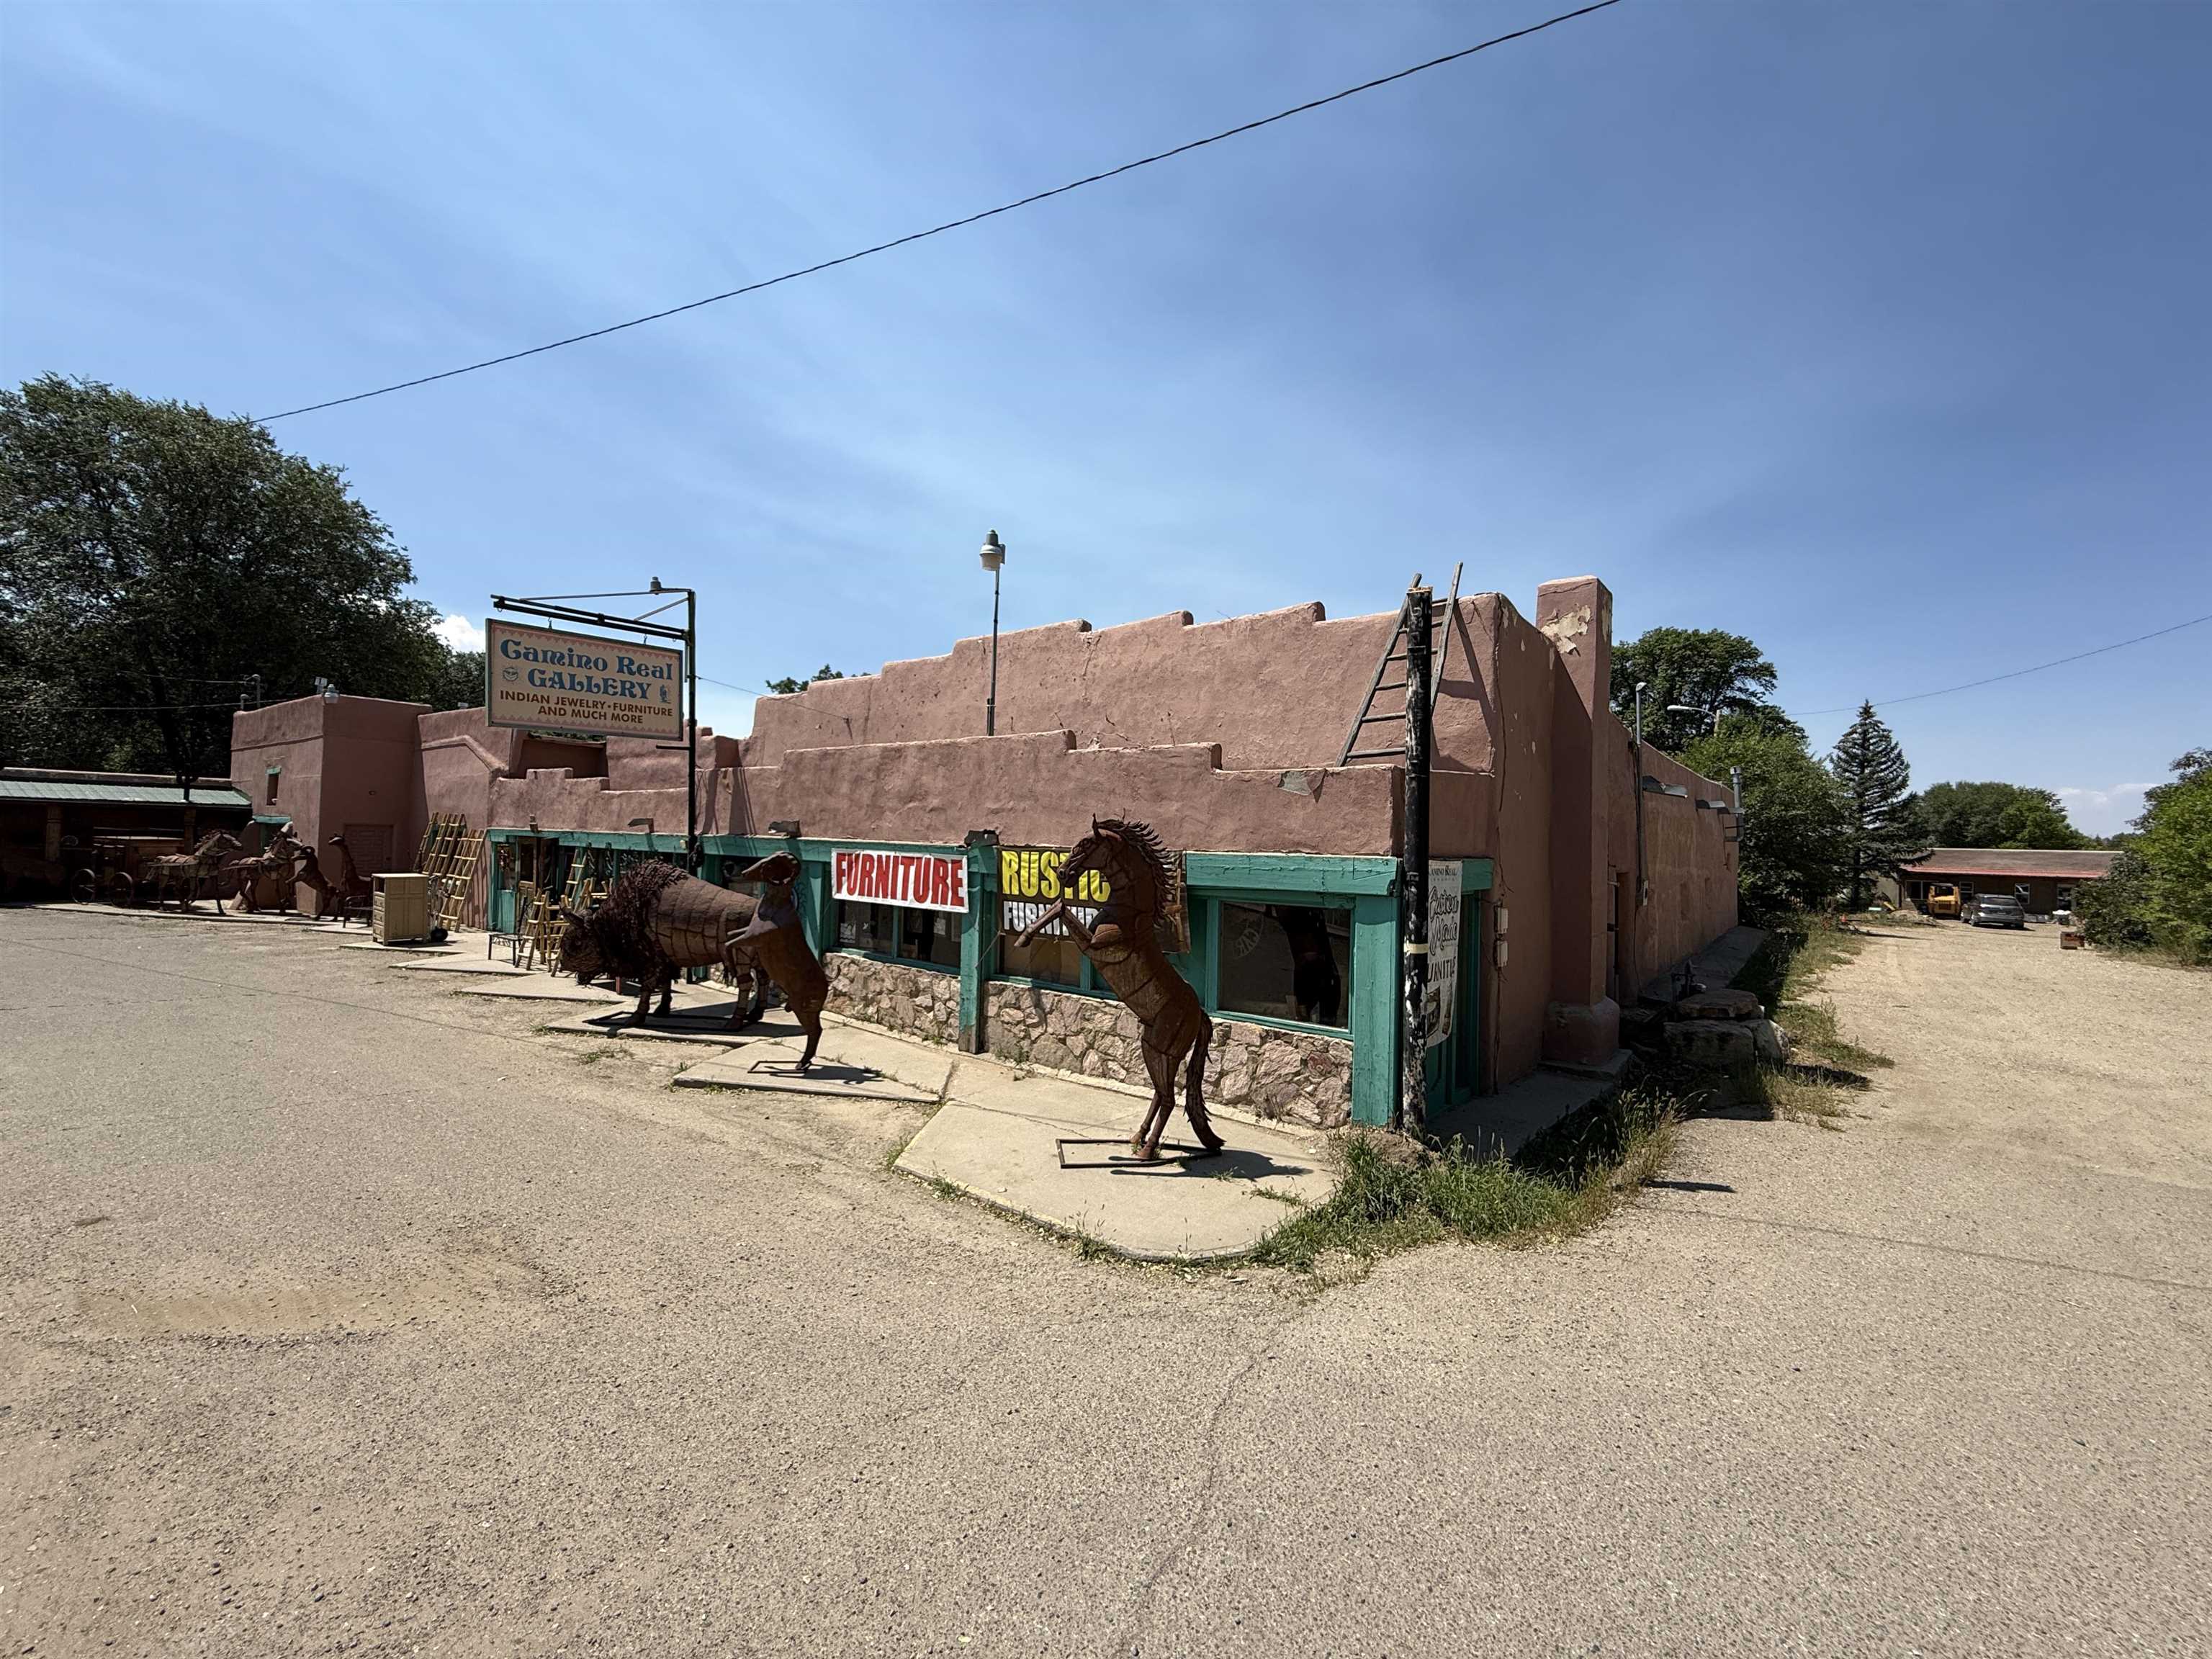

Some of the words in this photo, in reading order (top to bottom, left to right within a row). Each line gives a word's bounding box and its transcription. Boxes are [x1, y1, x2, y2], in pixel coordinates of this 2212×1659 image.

[500, 639, 608, 672] Camino
[616, 655, 673, 680] Real
[527, 667, 652, 700] GALLERY
[500, 690, 550, 705] INDIAN
[554, 696, 606, 710] JEWELRY
[613, 702, 673, 717] FURNITURE
[538, 704, 567, 717] AND
[571, 709, 607, 721] MUCH
[611, 711, 643, 724] MORE
[835, 851, 966, 907] FURNITURE
